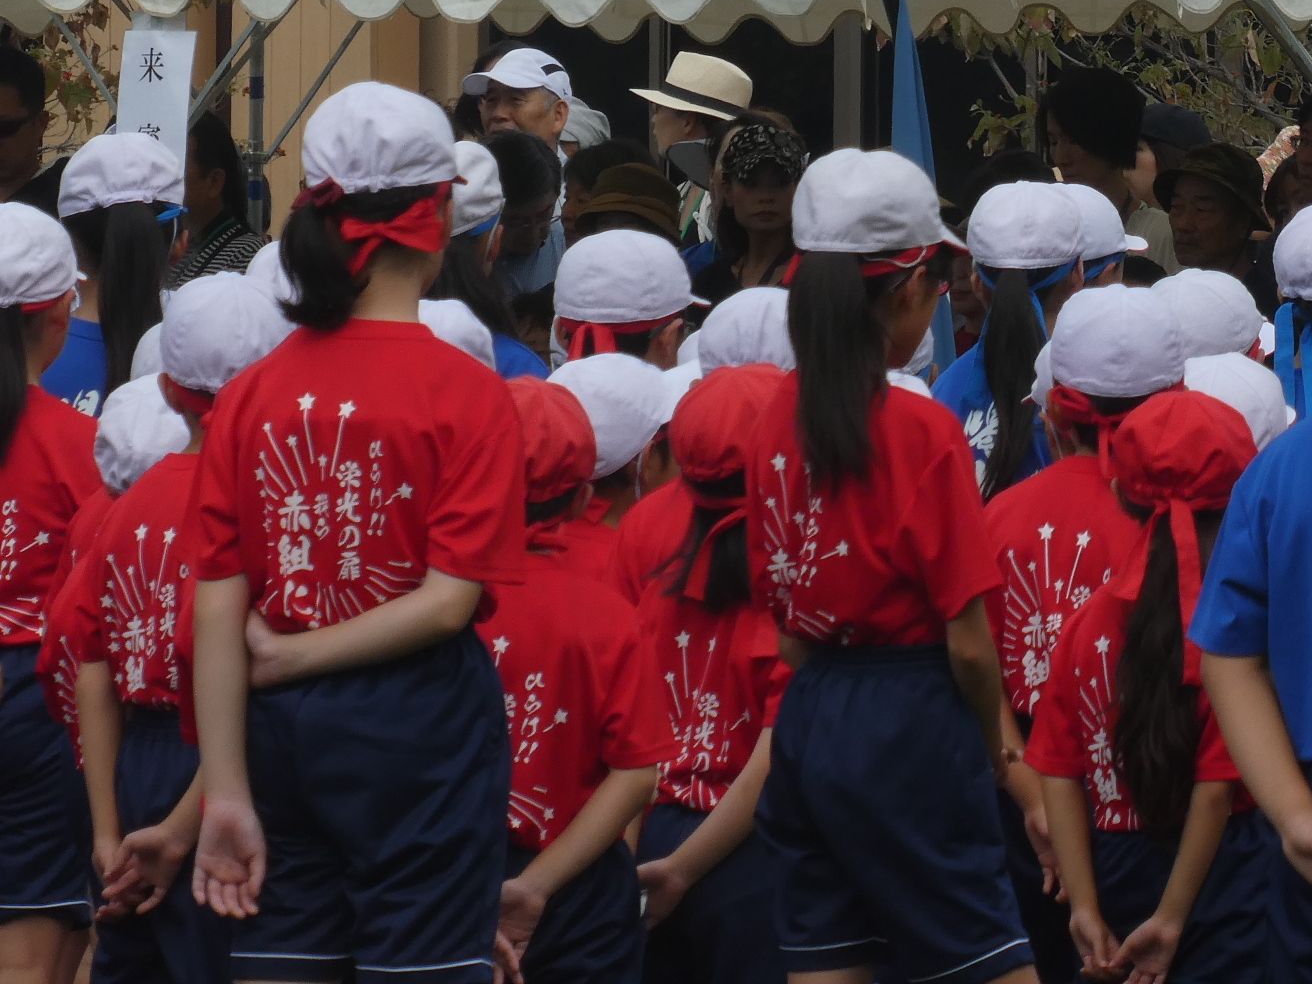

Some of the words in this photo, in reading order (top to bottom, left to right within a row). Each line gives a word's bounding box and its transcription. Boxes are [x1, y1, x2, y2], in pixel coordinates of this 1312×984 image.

[277, 491, 319, 629] 赤組に
[336, 461, 362, 581] 栄光の扉
